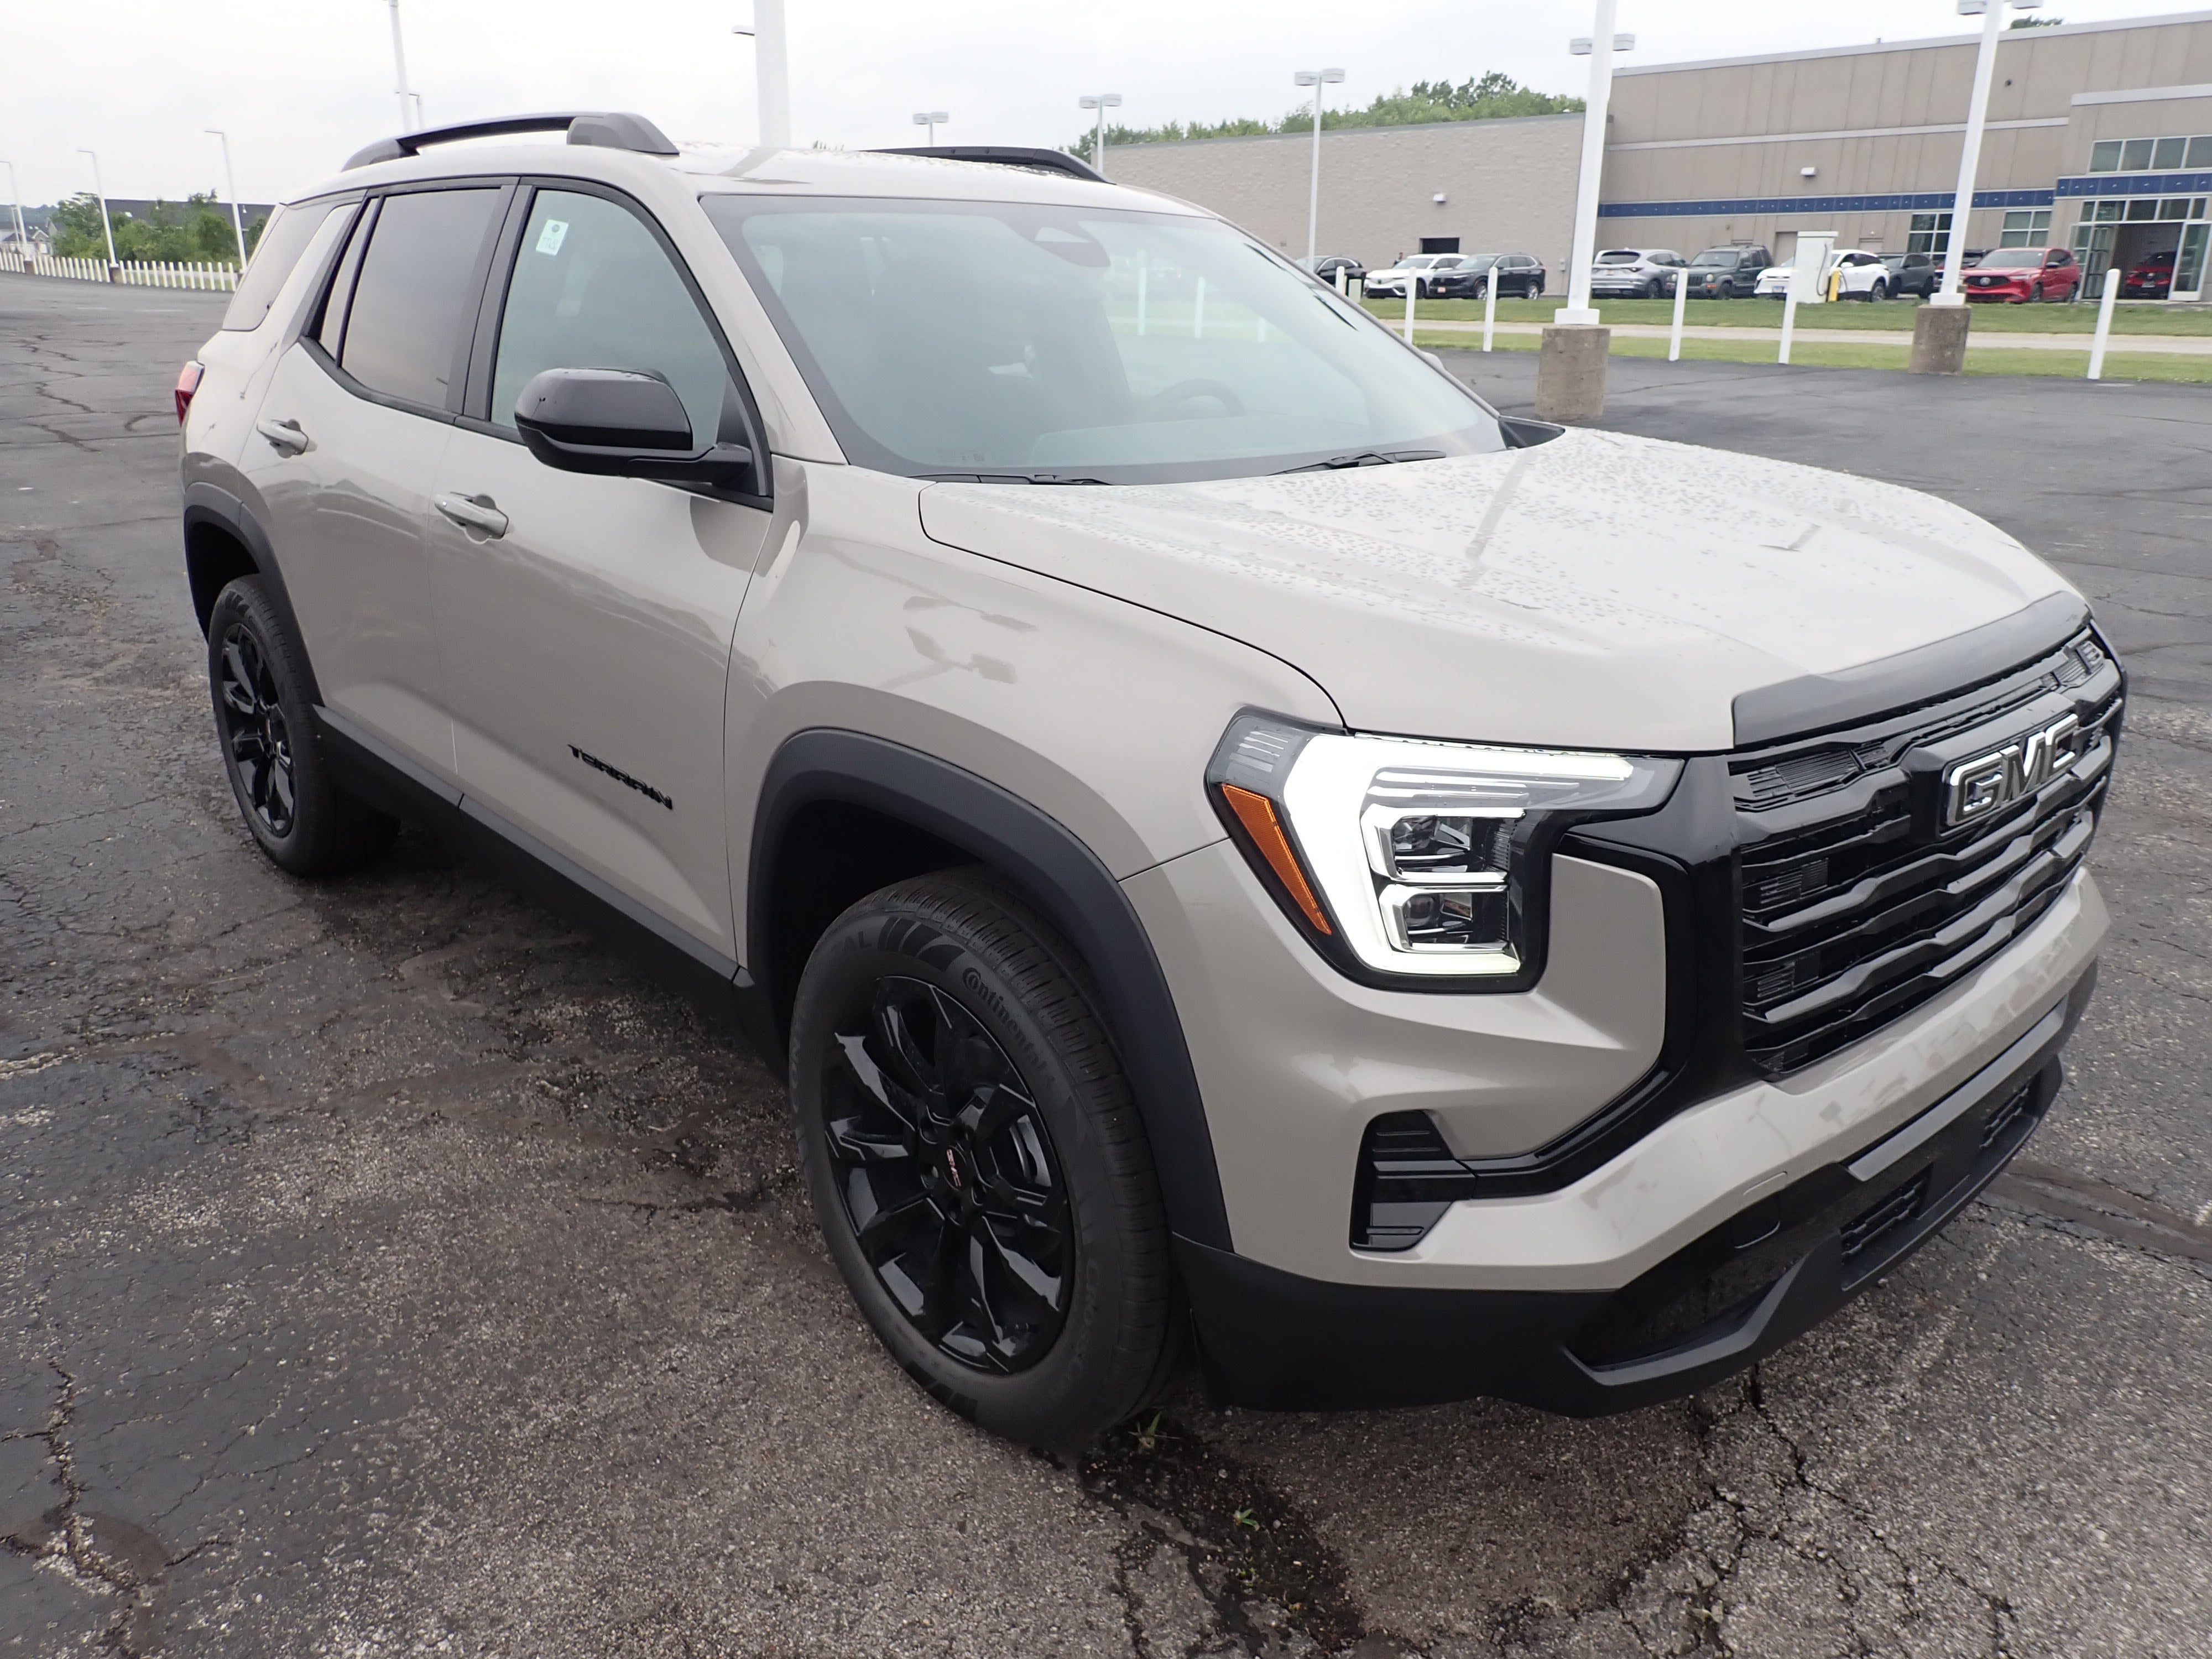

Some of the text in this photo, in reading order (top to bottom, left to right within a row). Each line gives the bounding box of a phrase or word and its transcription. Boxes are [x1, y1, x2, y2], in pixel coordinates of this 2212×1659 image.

[567, 744, 673, 810] TERRAIN
[1946, 713, 2079, 827] GMC
[962, 967, 1048, 1072] Continental
